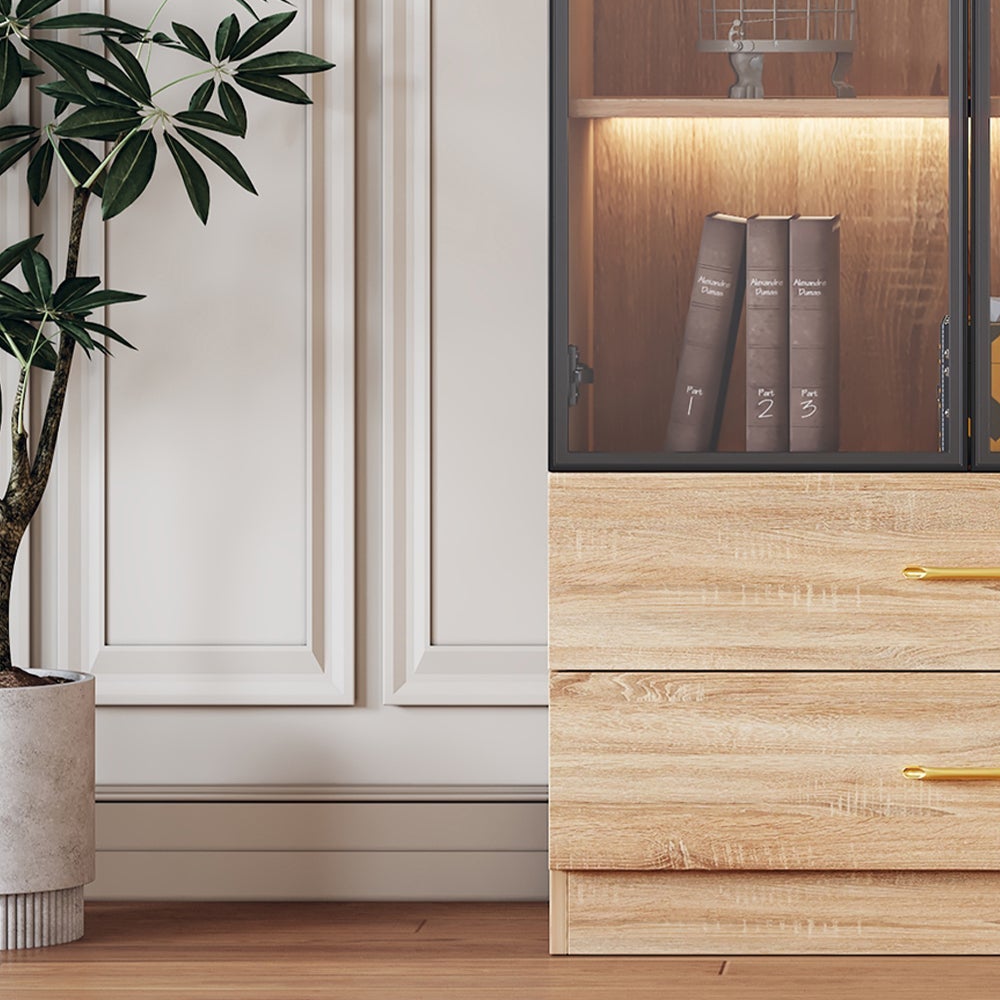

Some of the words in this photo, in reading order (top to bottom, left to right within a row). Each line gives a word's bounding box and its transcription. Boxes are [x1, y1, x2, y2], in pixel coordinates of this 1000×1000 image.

[698, 276, 731, 288] Alexandre
[751, 278, 784, 287] Alexandre
[793, 278, 827, 287] Alexandre
[701, 286, 724, 296] Dumas
[755, 288, 778, 296] Dumas
[798, 288, 821, 296] Dumas
[686, 386, 703, 395] Part
[758, 388, 775, 396] Part
[801, 388, 818, 396] Part
[687, 396, 693, 415] 1
[758, 398, 774, 418] 2
[800, 399, 817, 418] 3
